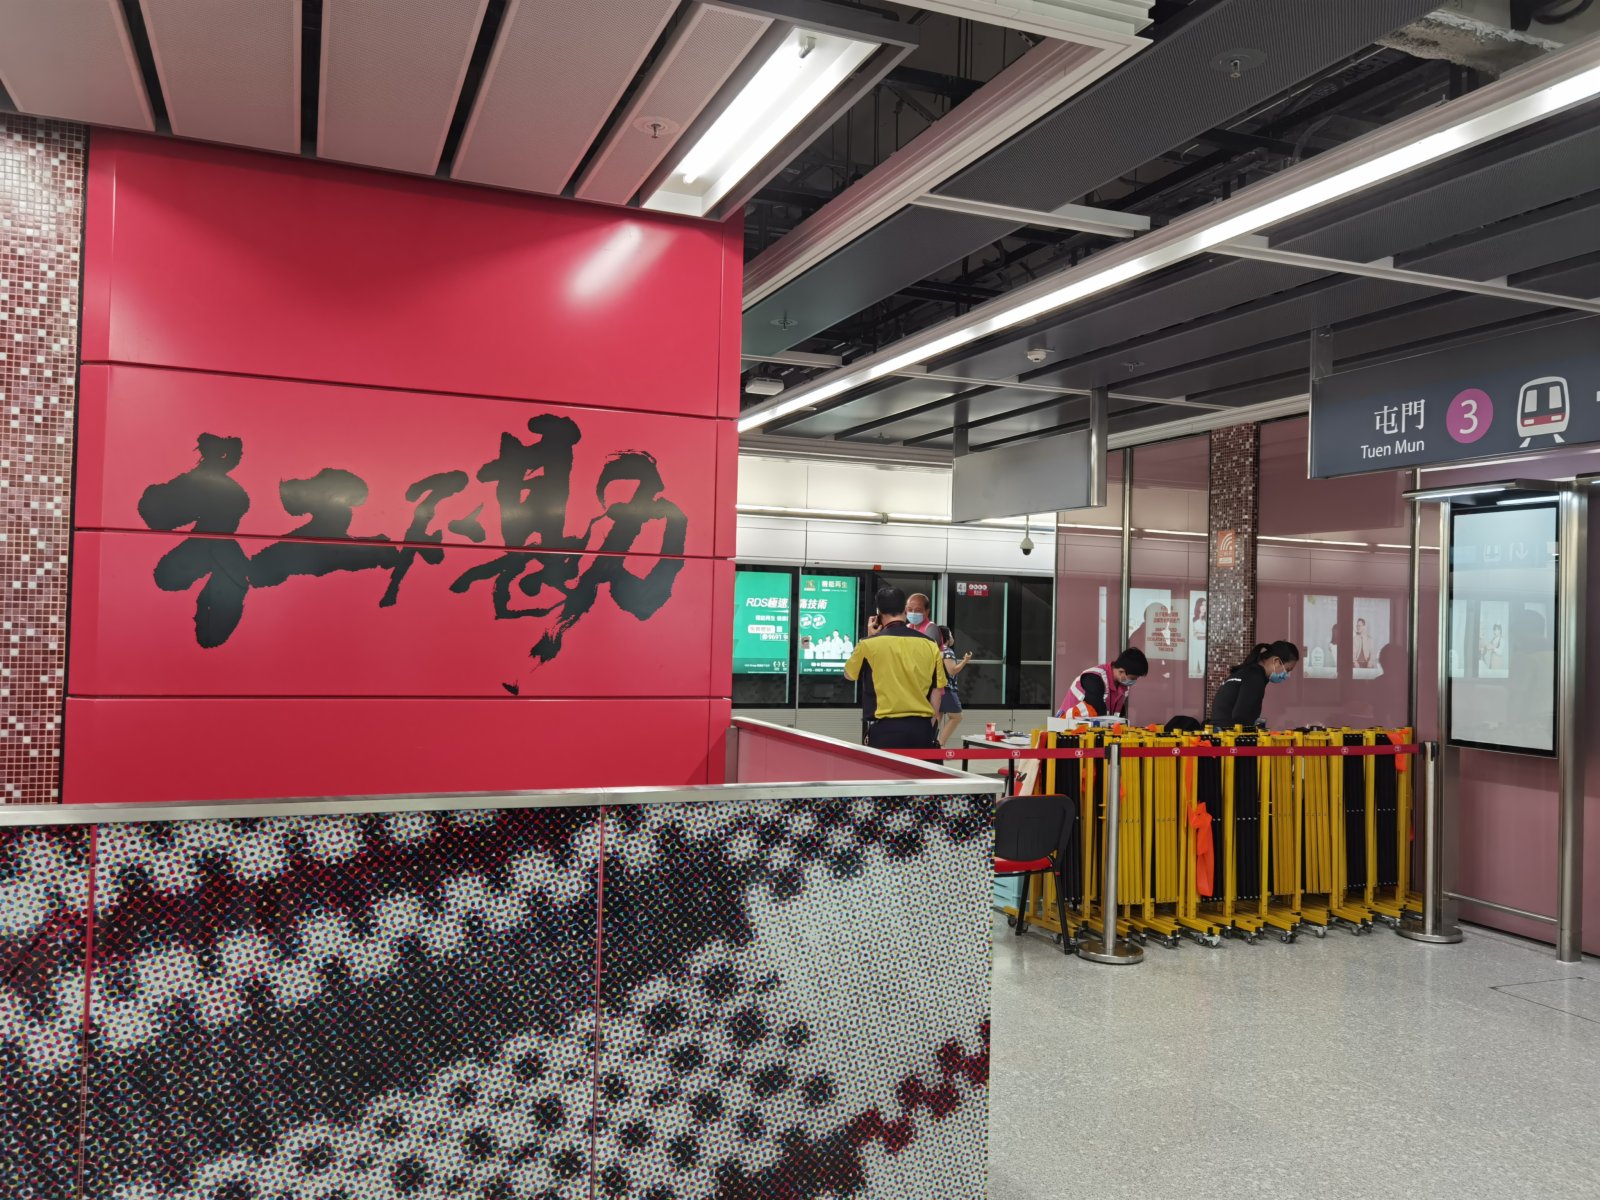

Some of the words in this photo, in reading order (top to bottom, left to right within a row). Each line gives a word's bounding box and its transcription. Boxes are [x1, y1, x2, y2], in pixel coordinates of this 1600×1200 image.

[1374, 399, 1426, 435] 屯門
[1460, 399, 1479, 435] 3
[1361, 444, 1392, 460] Tuen
[1394, 439, 1425, 455] Mun
